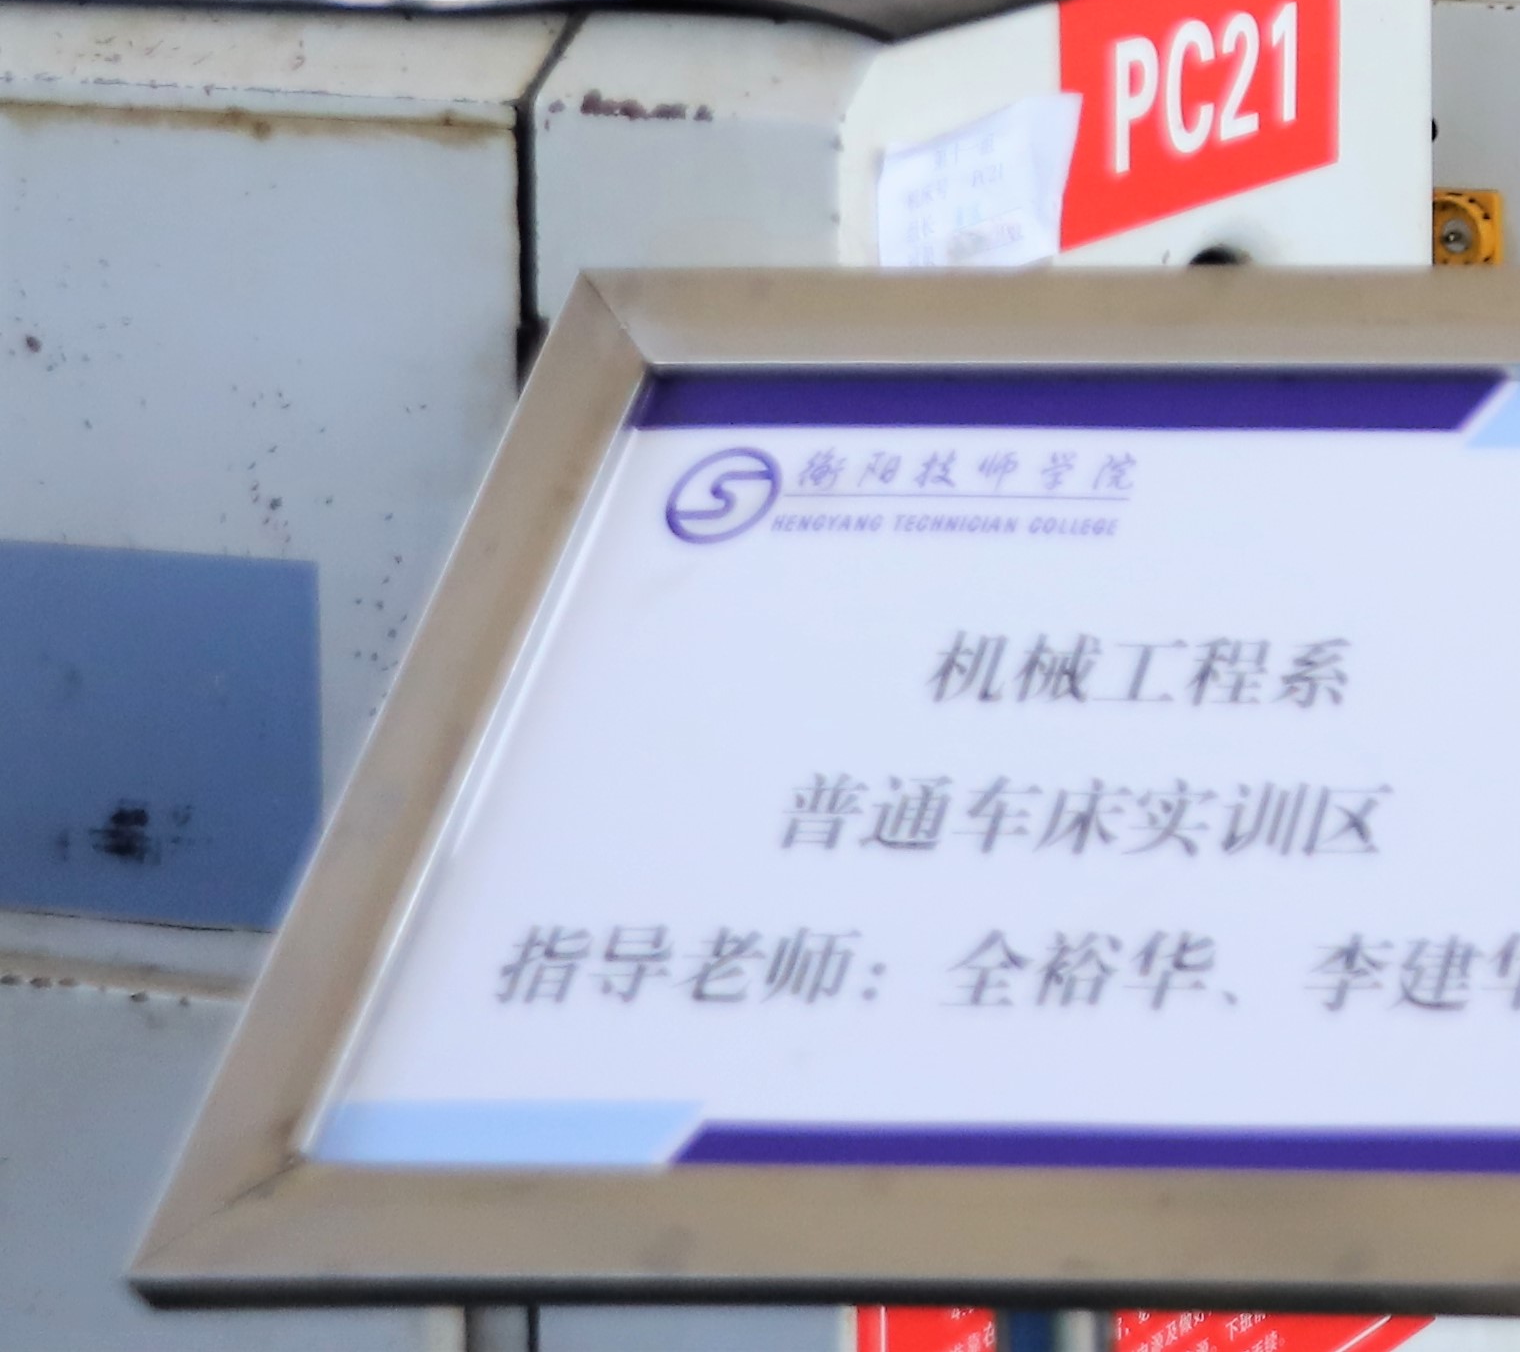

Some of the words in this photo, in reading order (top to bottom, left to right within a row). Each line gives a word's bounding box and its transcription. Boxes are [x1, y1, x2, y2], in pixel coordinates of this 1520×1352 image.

[1114, 1, 1298, 175] PC21
[770, 512, 884, 534] HENGYANG
[893, 513, 1019, 536] TECHNICIAN
[1028, 516, 1120, 537] COLLEGE
[926, 629, 1353, 710] 机械工程系
[778, 772, 1393, 859] 普通车床实训区
